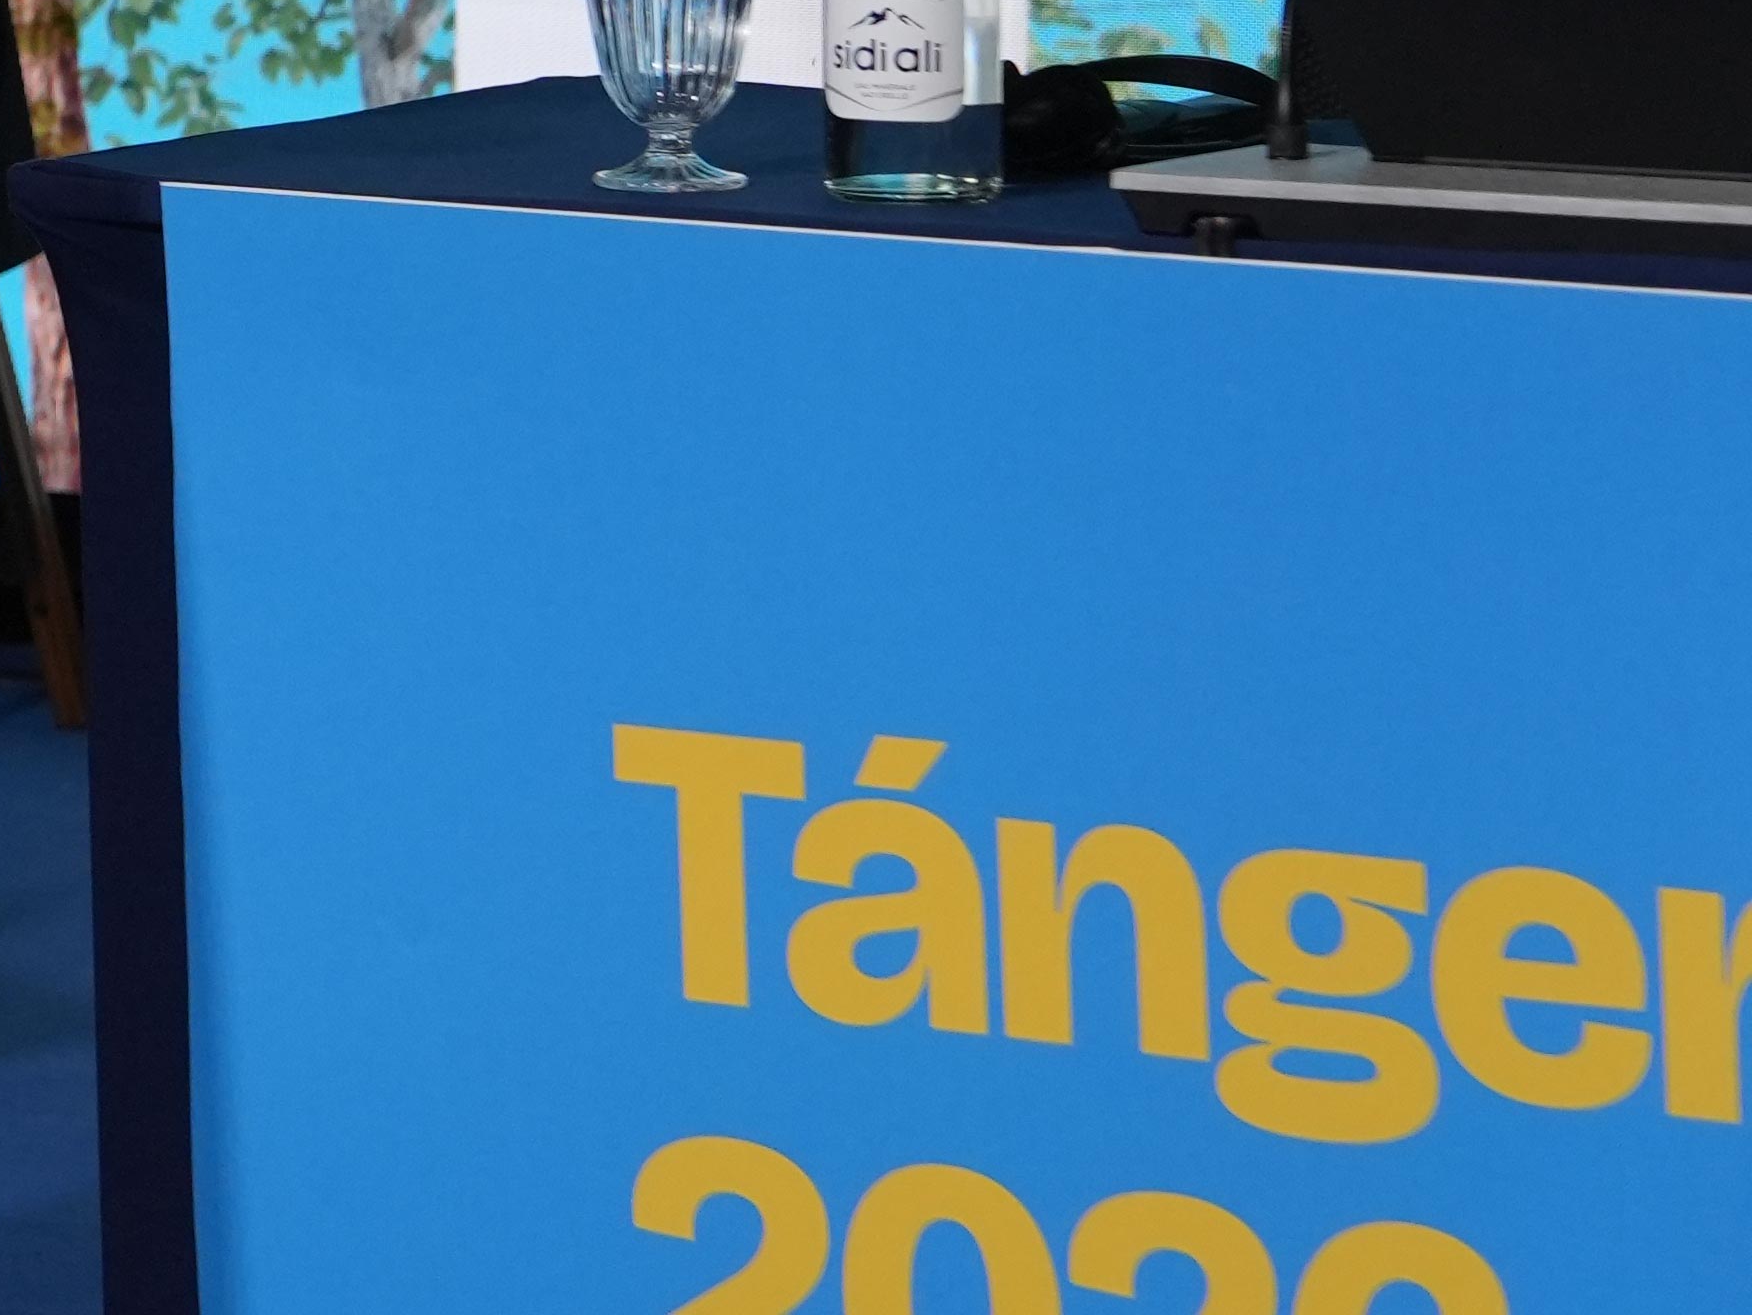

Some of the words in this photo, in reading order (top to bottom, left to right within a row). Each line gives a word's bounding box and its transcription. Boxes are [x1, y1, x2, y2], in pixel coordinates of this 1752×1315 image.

[833, 38, 888, 72] sidi
[894, 39, 944, 73] ali
[612, 723, 1752, 1144] Tánger
